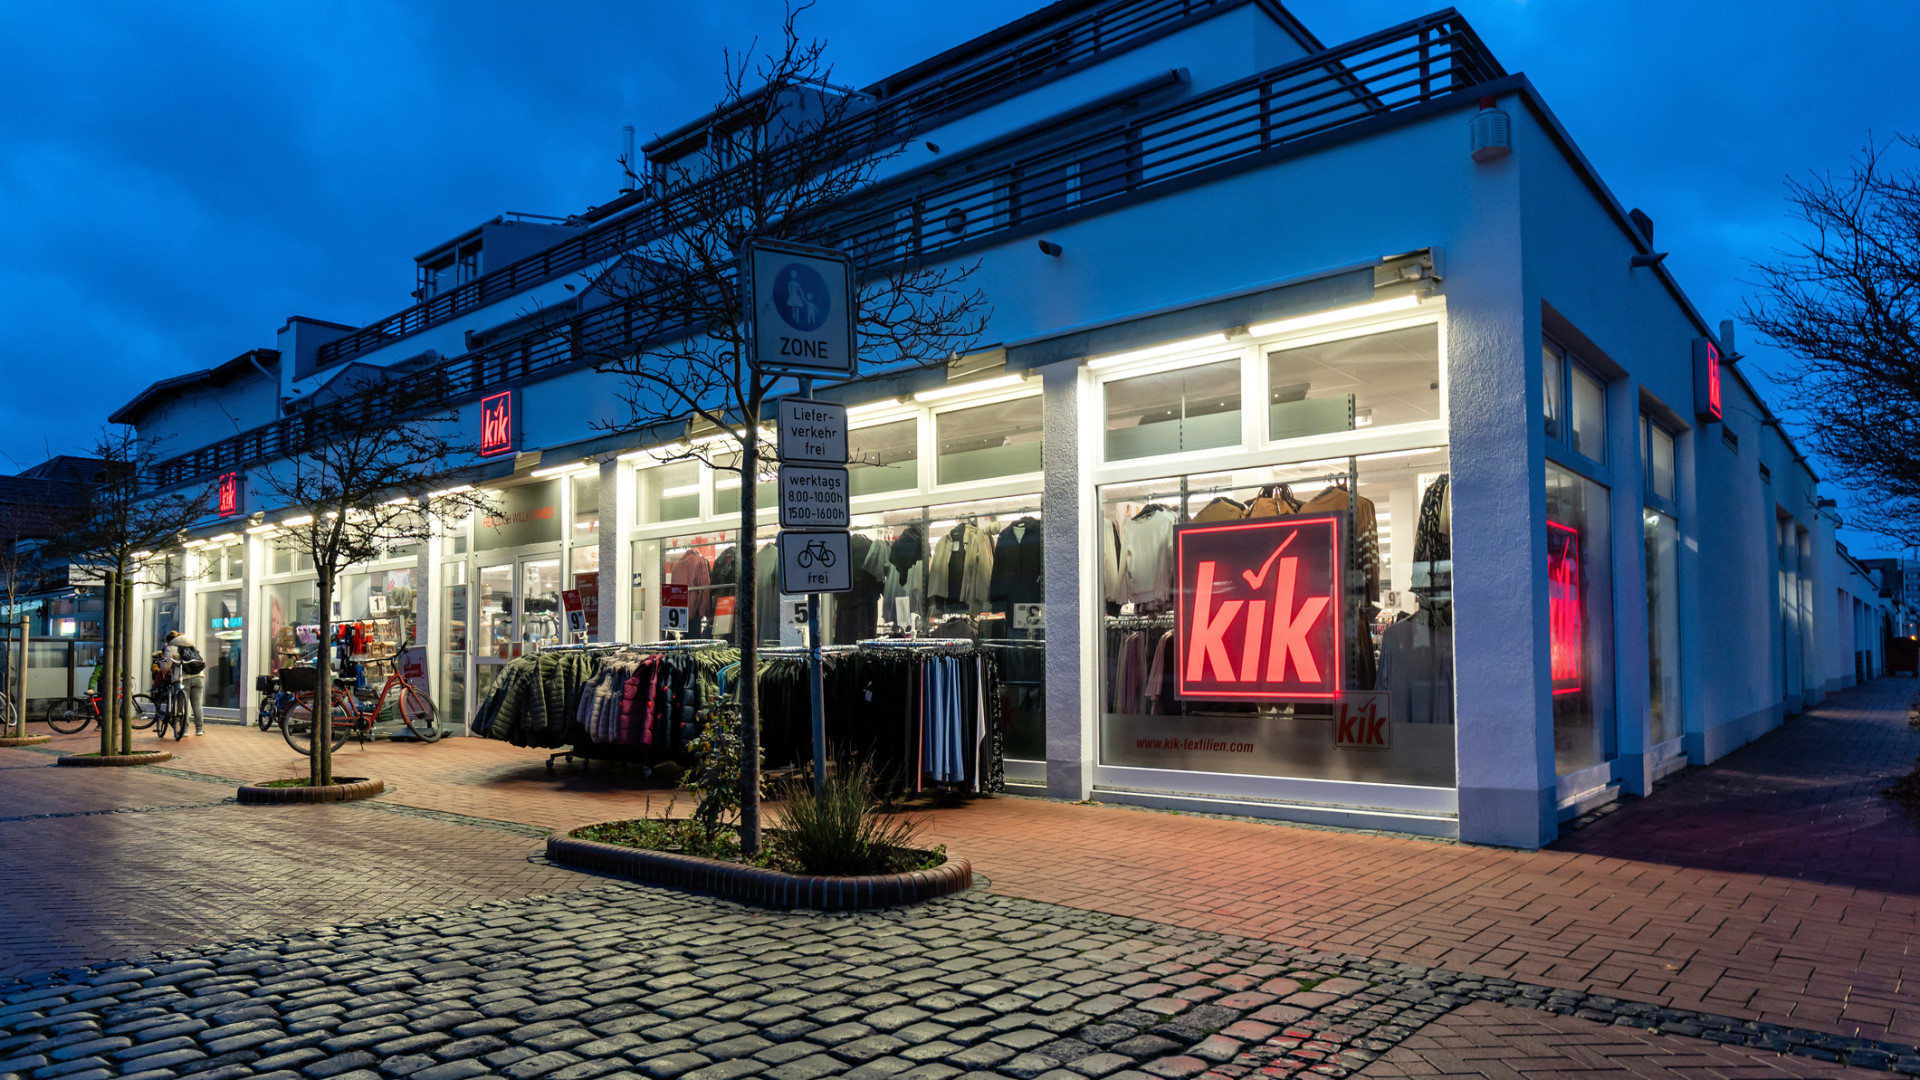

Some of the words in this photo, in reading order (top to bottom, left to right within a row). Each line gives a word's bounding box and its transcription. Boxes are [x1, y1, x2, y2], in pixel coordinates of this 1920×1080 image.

[780, 337, 828, 359] ZONE
[484, 397, 508, 449] kik
[793, 408, 834, 422] Liefer-
[791, 425, 837, 439] verkehr
[805, 442, 826, 455] frei
[789, 474, 841, 490] werktags
[807, 571, 828, 584] frei
[794, 602, 809, 624] 5
[1186, 529, 1331, 683] kik
[1337, 695, 1387, 745] kik
[1136, 738, 1254, 753] www.kik-textilien.com
